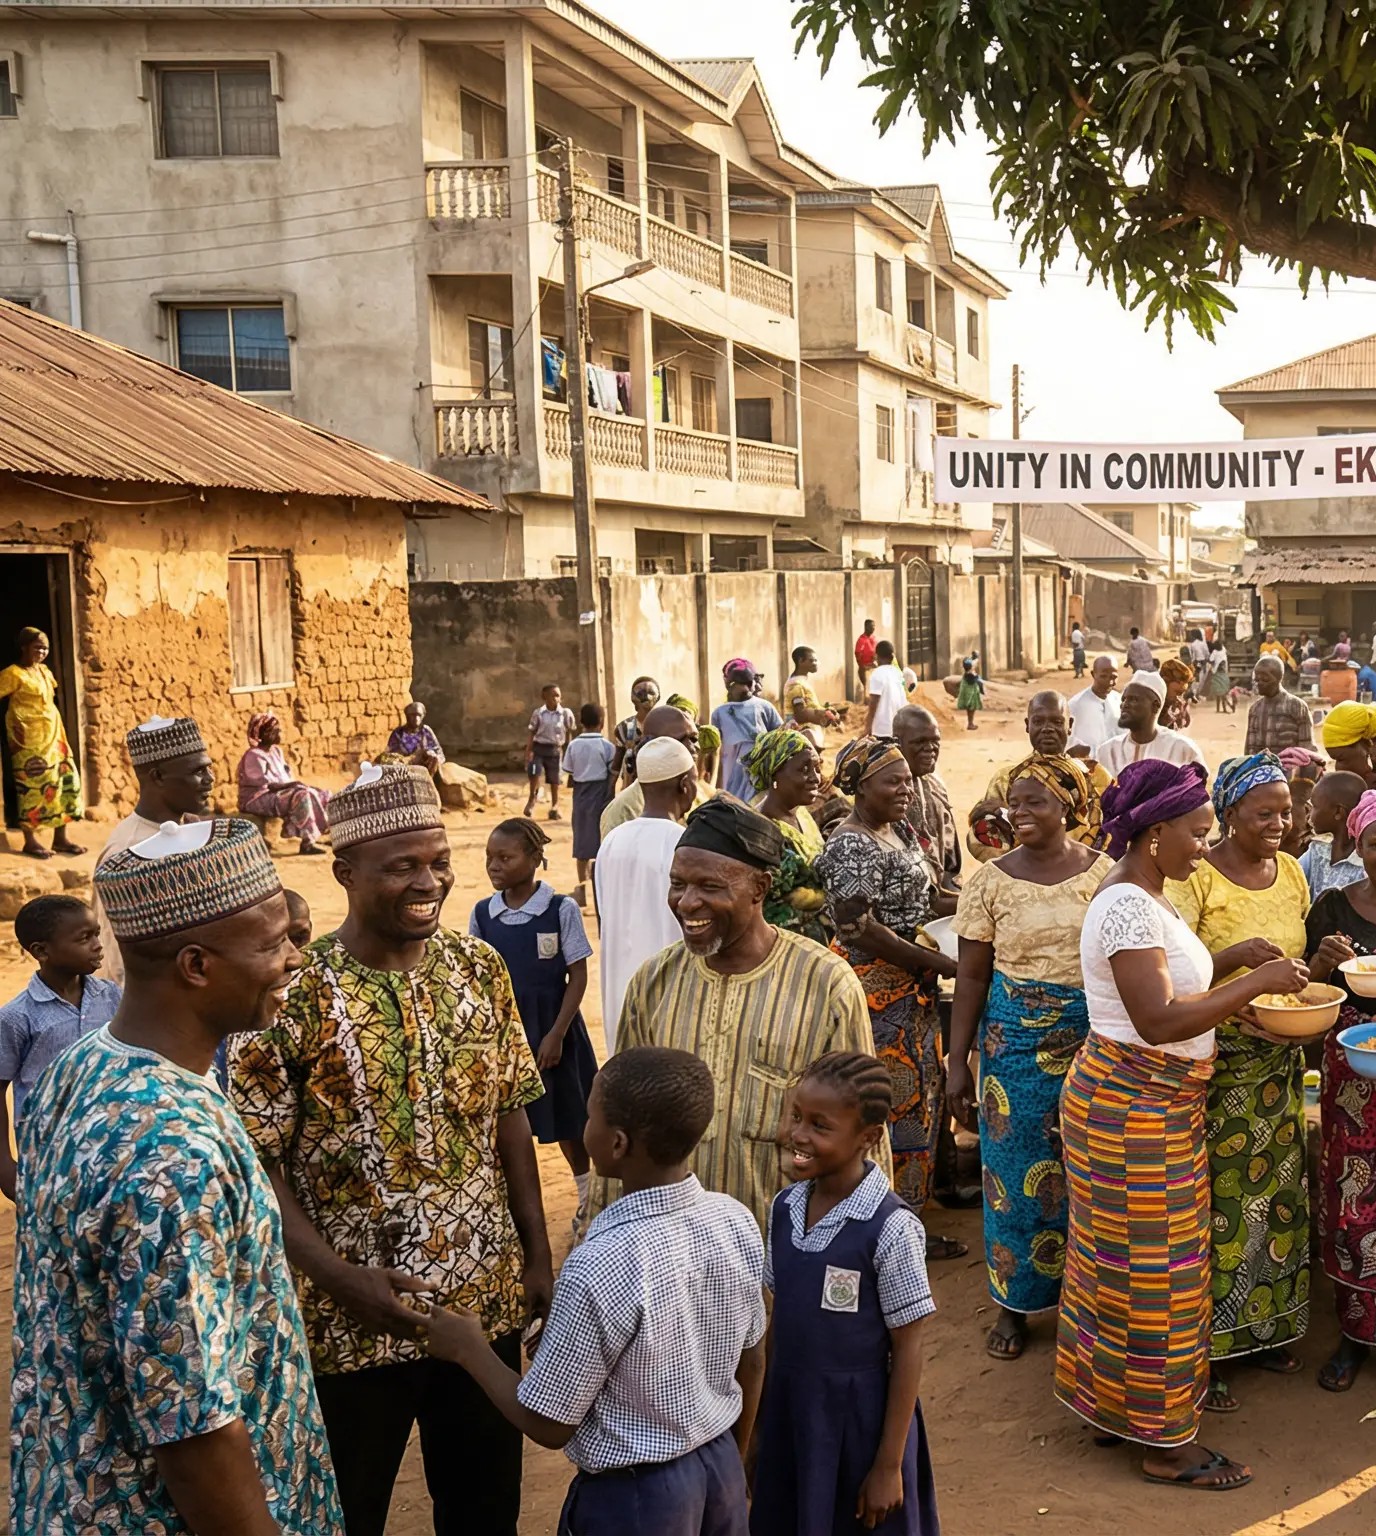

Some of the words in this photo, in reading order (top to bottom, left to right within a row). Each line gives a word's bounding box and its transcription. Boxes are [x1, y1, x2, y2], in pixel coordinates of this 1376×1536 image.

[949, 451, 1050, 489] UNITY
[1060, 453, 1092, 489] IN
[1103, 449, 1305, 490] COMMUNITY
